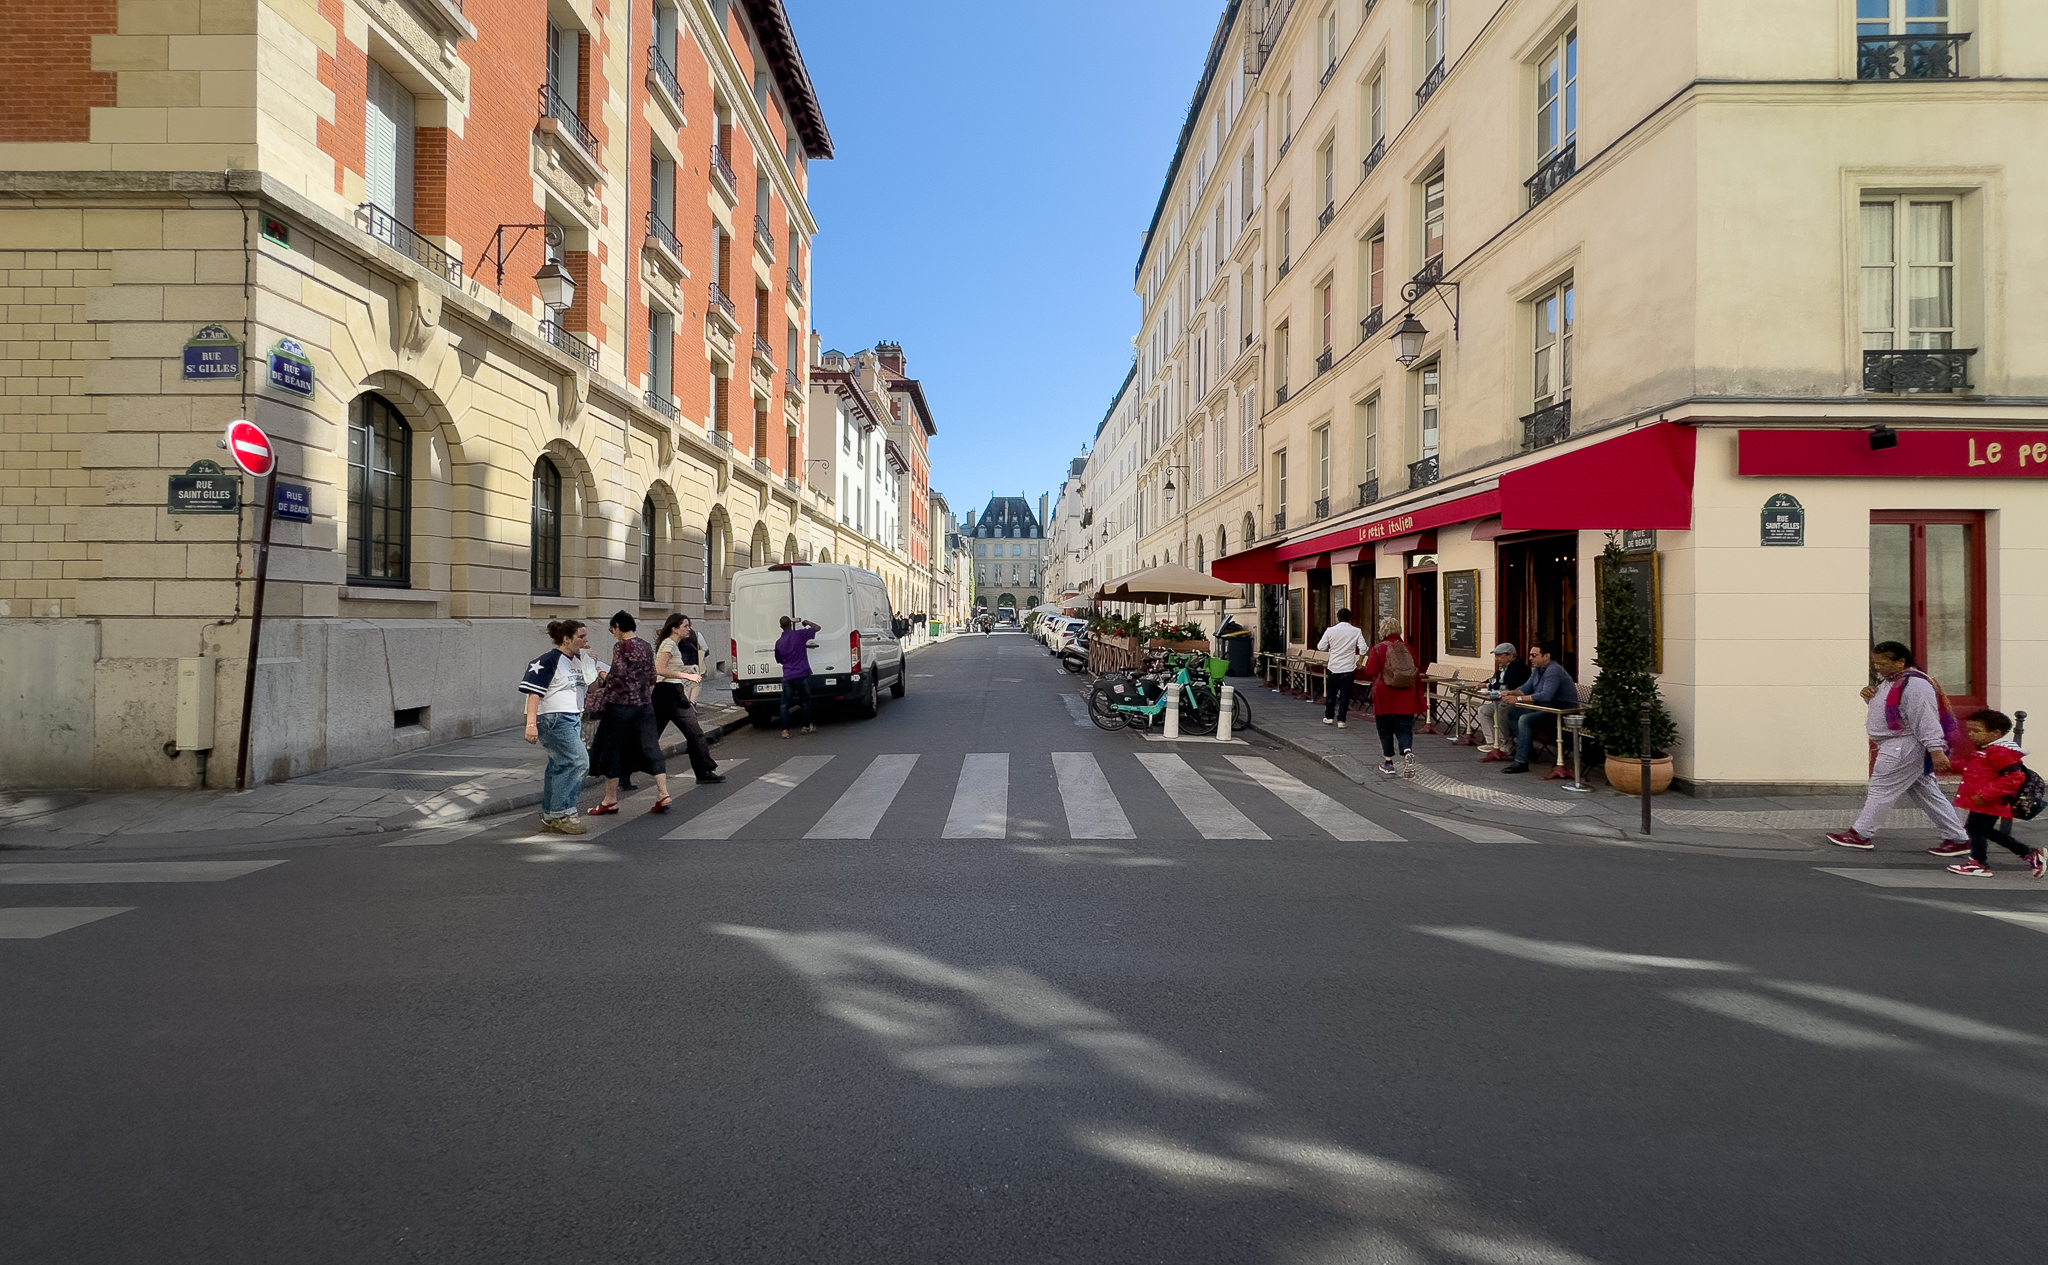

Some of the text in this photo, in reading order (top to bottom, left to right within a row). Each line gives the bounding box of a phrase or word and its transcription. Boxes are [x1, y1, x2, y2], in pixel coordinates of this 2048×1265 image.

[202, 352, 221, 361] RUE
[198, 364, 237, 373] GILLES
[283, 363, 300, 376] RUE
[272, 370, 311, 391] DE BÉARN
[1968, 438, 2047, 467] Le pe
[196, 480, 213, 489] RUE
[178, 490, 231, 499] SAINT GILLES
[286, 491, 303, 502] RUE
[278, 502, 288, 511] DE
[1359, 516, 1413, 541] Le petit italien
[1632, 529, 1646, 538] RUE
[747, 663, 769, 675] 80 90
